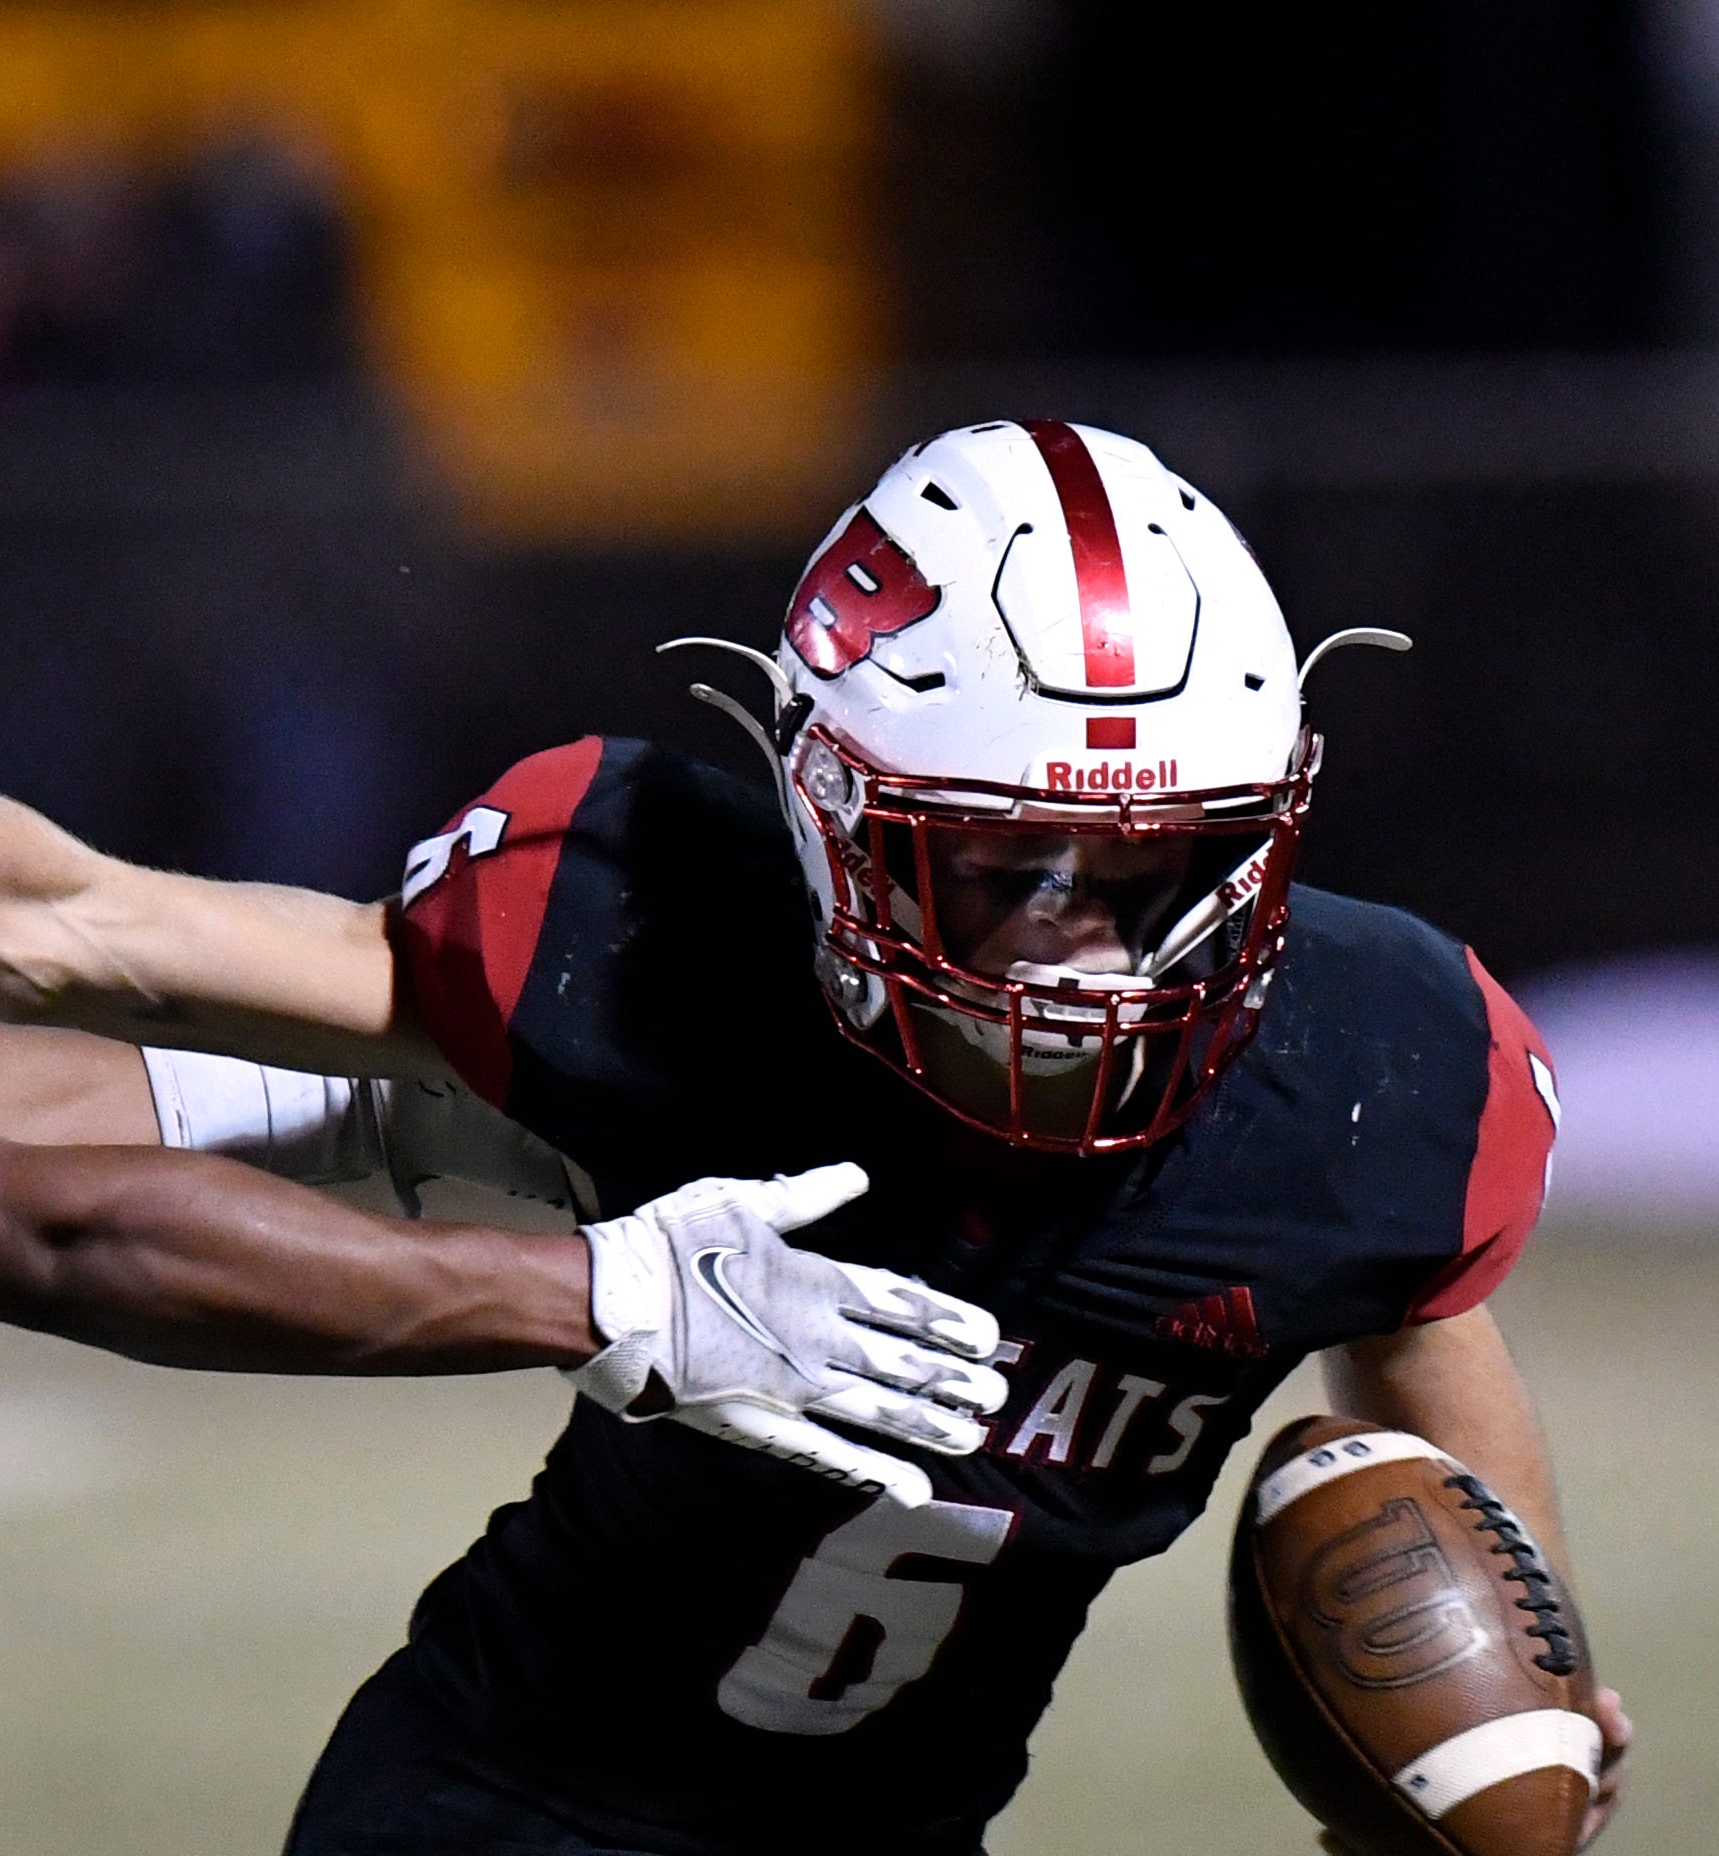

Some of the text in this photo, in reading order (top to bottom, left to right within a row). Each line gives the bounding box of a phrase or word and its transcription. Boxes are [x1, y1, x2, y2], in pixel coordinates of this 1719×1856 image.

[1045, 758, 1178, 791] Riddell
[1214, 849, 1270, 910] Rid
[980, 1340, 1230, 1475] ATS
[717, 1496, 1015, 1736] 6
